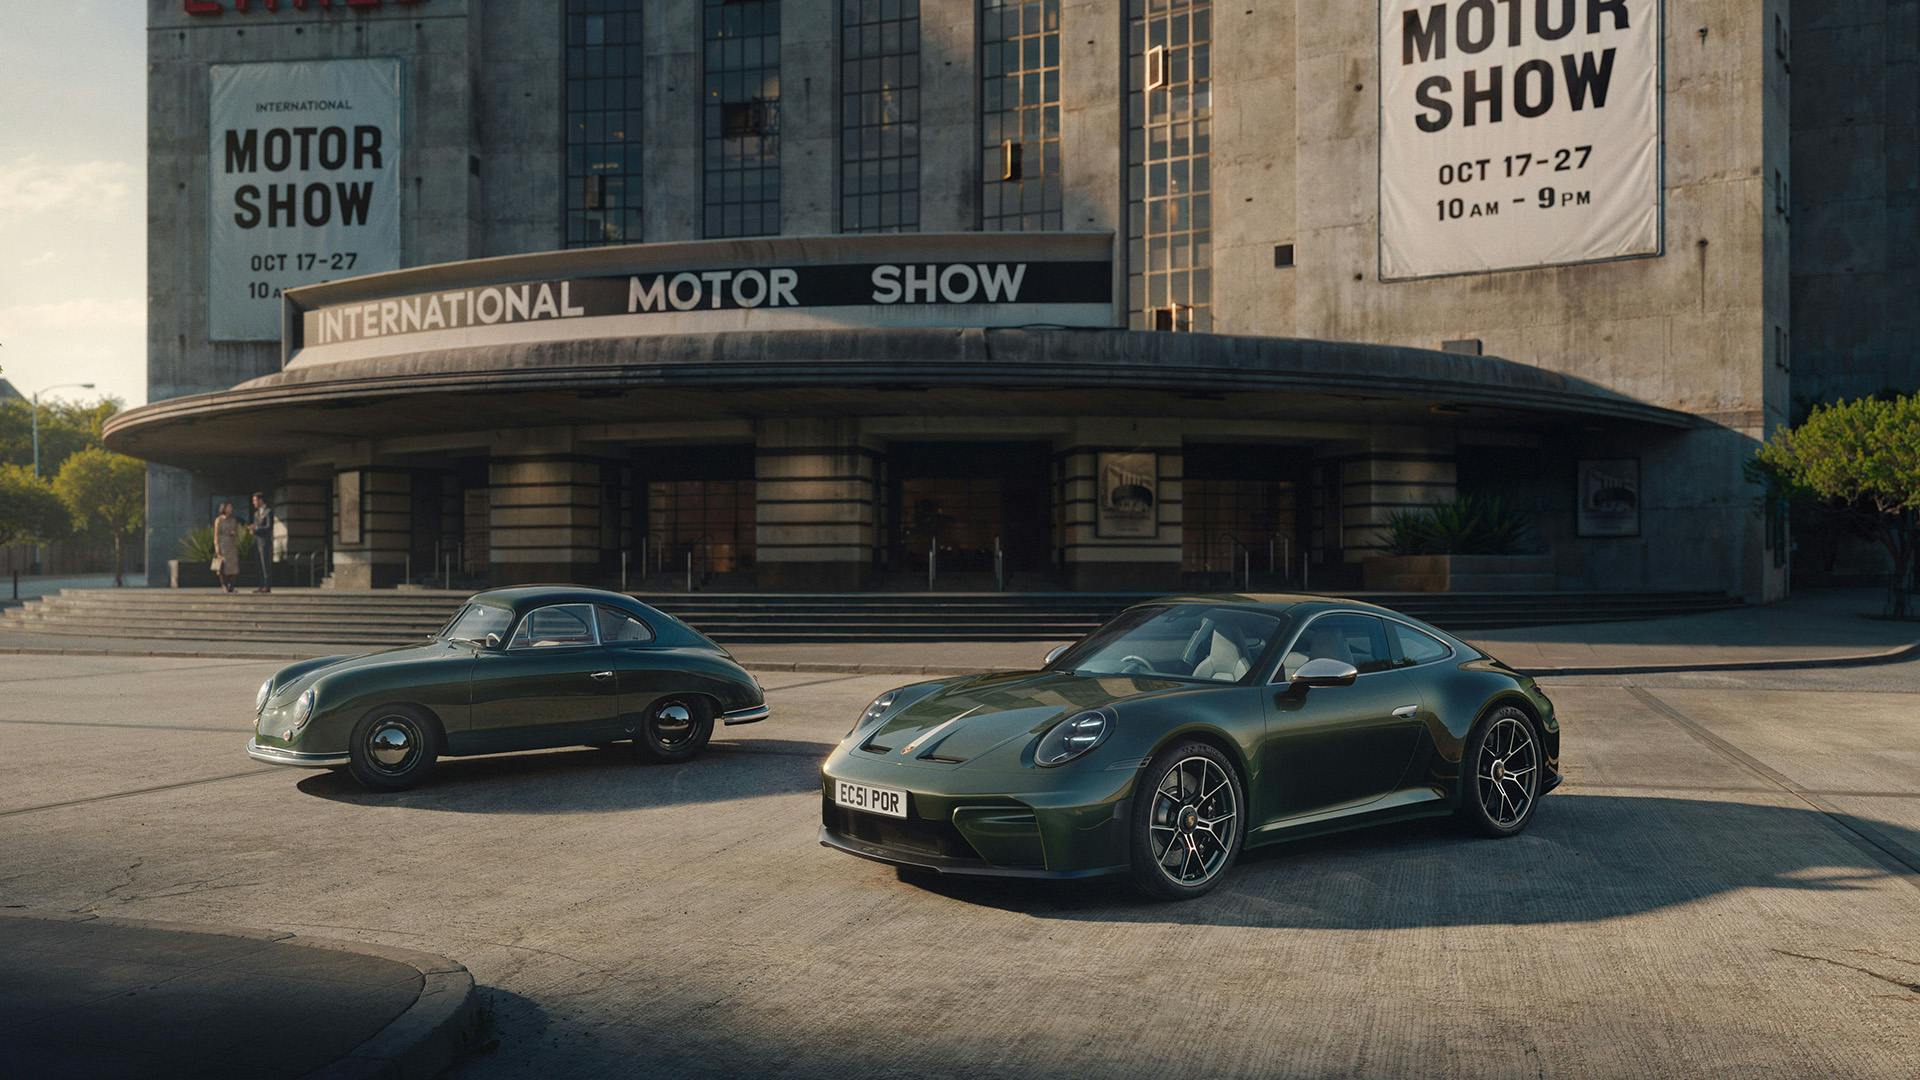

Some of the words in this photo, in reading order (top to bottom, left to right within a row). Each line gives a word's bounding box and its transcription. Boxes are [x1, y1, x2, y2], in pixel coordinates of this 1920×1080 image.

[1402, 0, 1631, 66] MOTOR
[256, 100, 352, 113] INTERNATIONAL
[1415, 48, 1617, 133] SHOW
[225, 125, 383, 174] MOTOR
[1439, 159, 1491, 185] OCT
[1504, 145, 1593, 178] 17-27
[234, 181, 374, 230] SHOW
[251, 254, 288, 272] OCT
[296, 252, 358, 271] 17-27
[318, 281, 585, 344] INTERNATIONAL
[627, 269, 800, 313] MOTOR
[871, 263, 1027, 305] SHOW
[872, 789, 900, 813] POR
